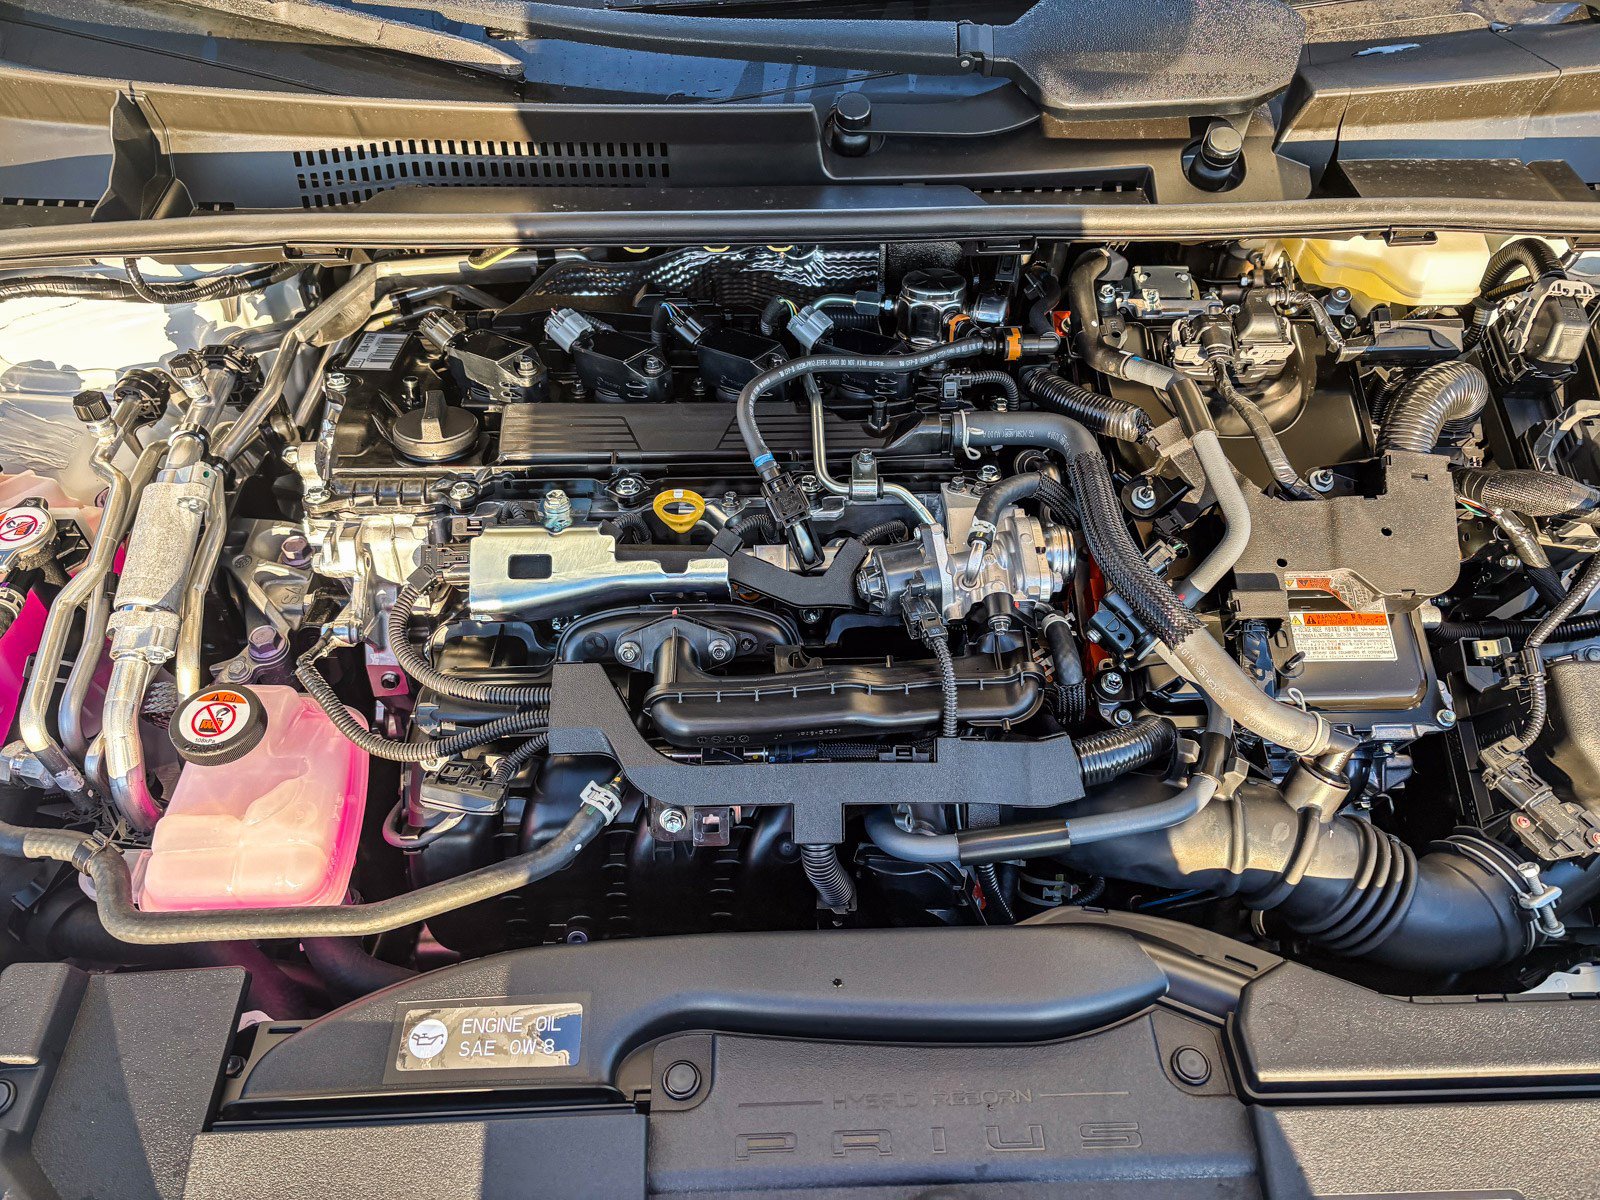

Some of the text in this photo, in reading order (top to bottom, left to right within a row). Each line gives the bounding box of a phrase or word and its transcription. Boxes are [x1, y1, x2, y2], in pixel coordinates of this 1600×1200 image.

[461, 1015, 562, 1034] ENGINE OIL
[458, 1038, 555, 1057] SAE 0W-8
[833, 1089, 1032, 1109] HYBRID REBORN
[735, 1121, 1144, 1161] PRIUS
